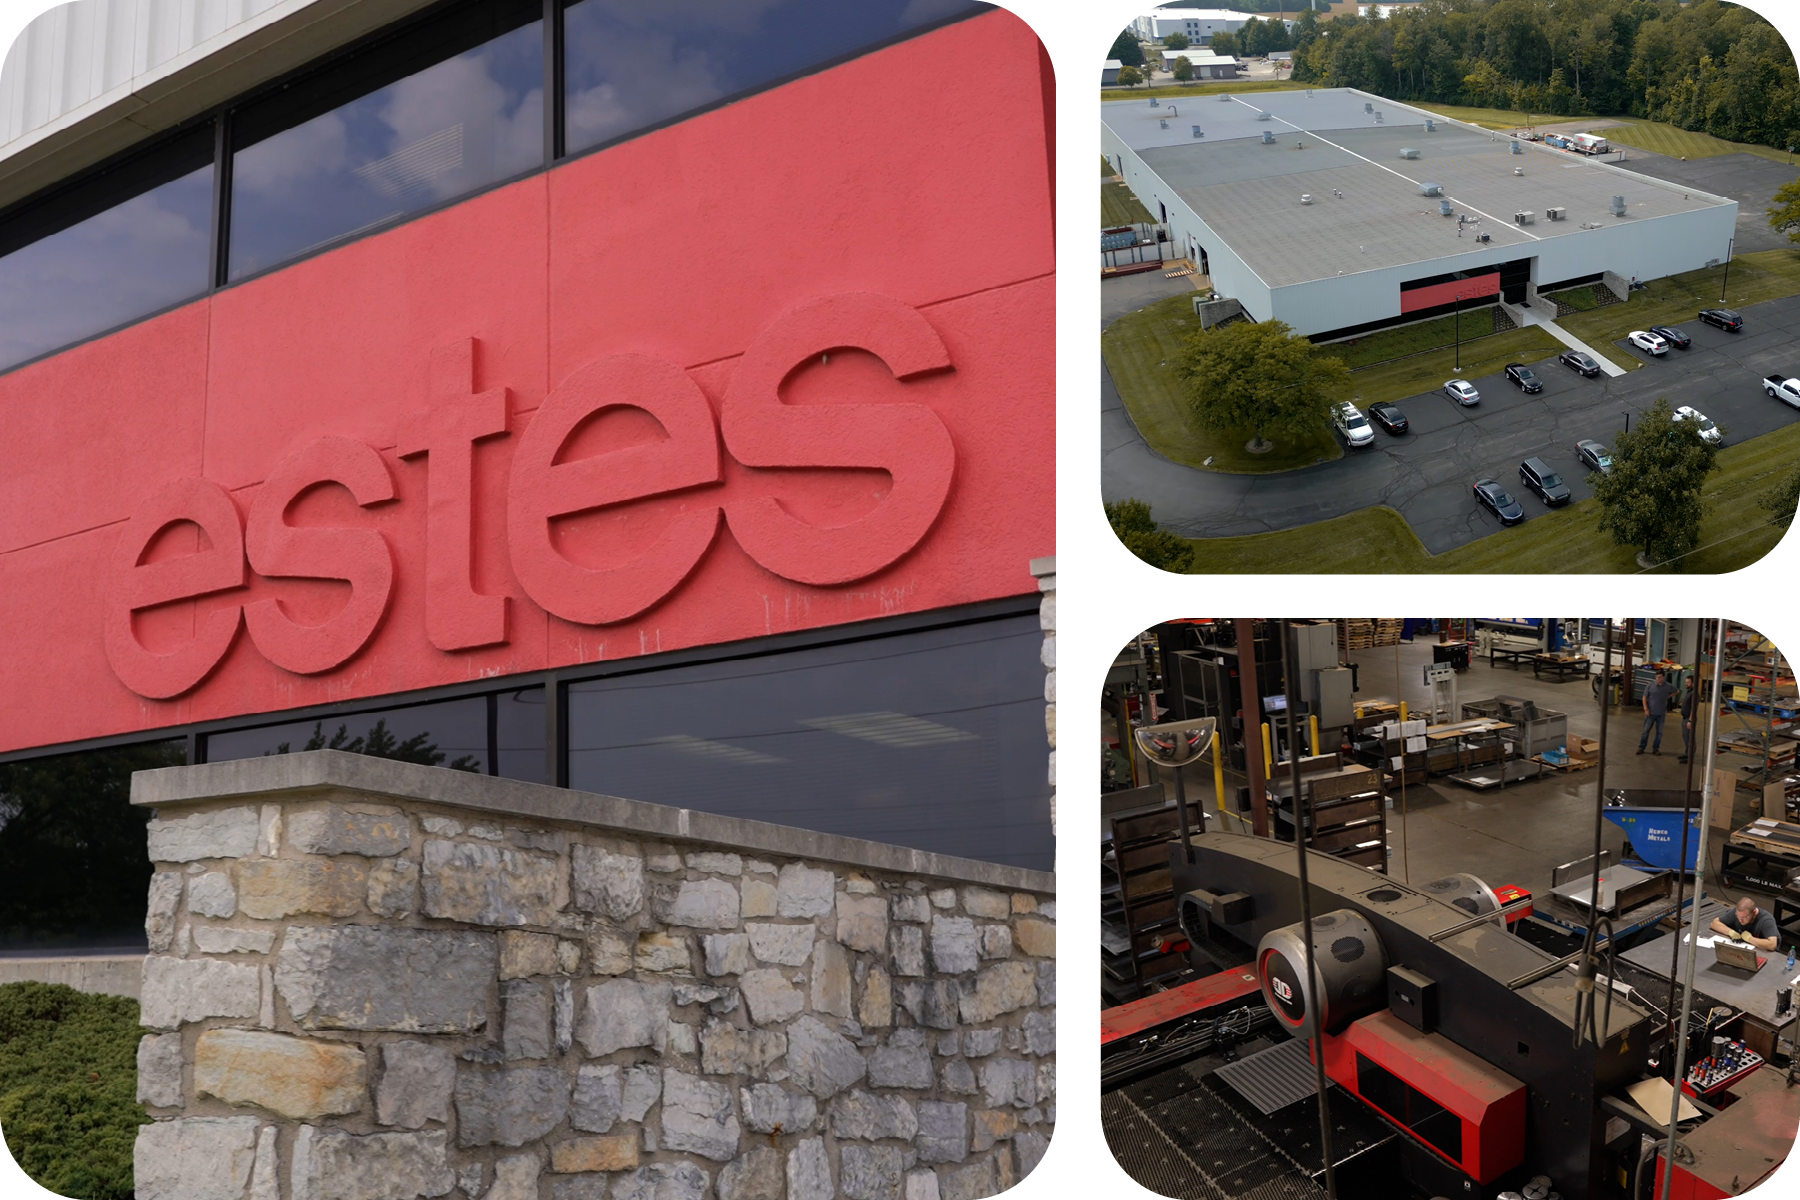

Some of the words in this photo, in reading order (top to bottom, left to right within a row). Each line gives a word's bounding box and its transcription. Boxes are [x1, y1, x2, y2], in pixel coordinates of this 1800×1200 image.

[1455, 283, 1496, 299] estes
[105, 292, 957, 698] estes
[1367, 774, 1378, 784] 23
[1369, 825, 1377, 833] 19
